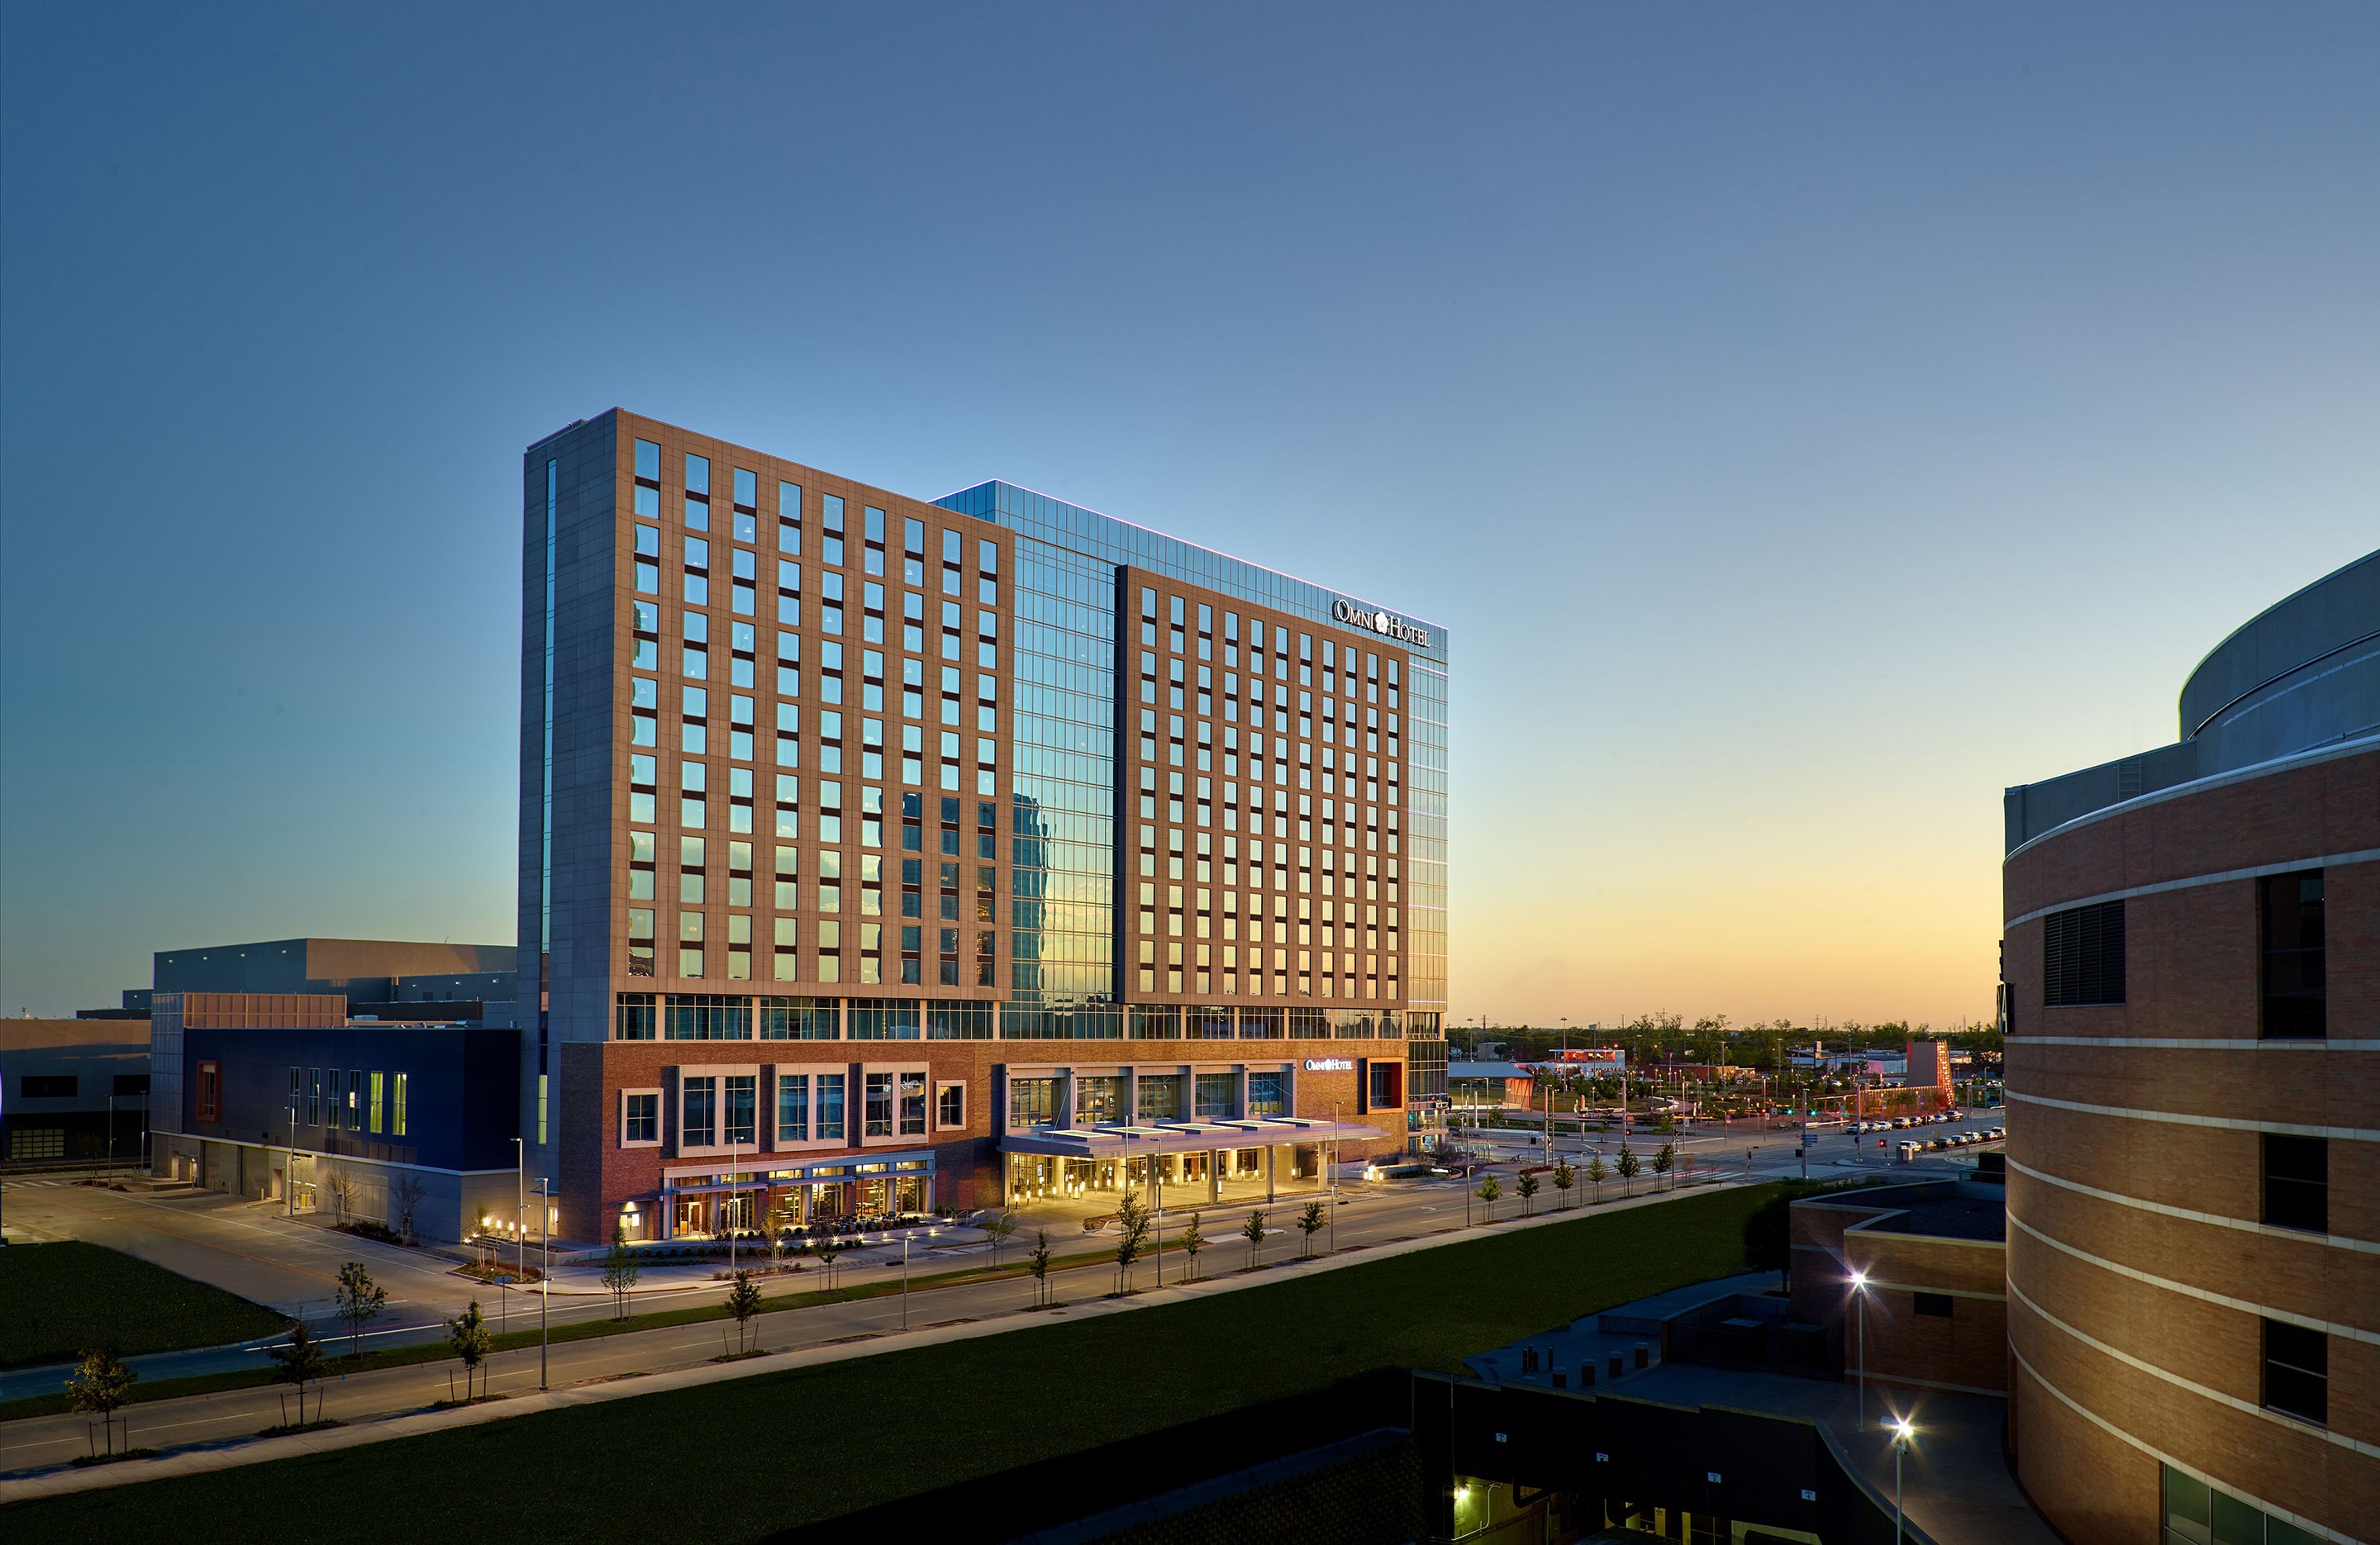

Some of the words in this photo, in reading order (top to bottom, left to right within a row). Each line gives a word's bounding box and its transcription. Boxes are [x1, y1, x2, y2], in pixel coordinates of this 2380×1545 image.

[1333, 599, 1374, 630] OMNI
[1389, 615, 1430, 648] HOTEL
[1305, 1059, 1325, 1071] OMNI
[1331, 1058, 1354, 1071] HOTEL
